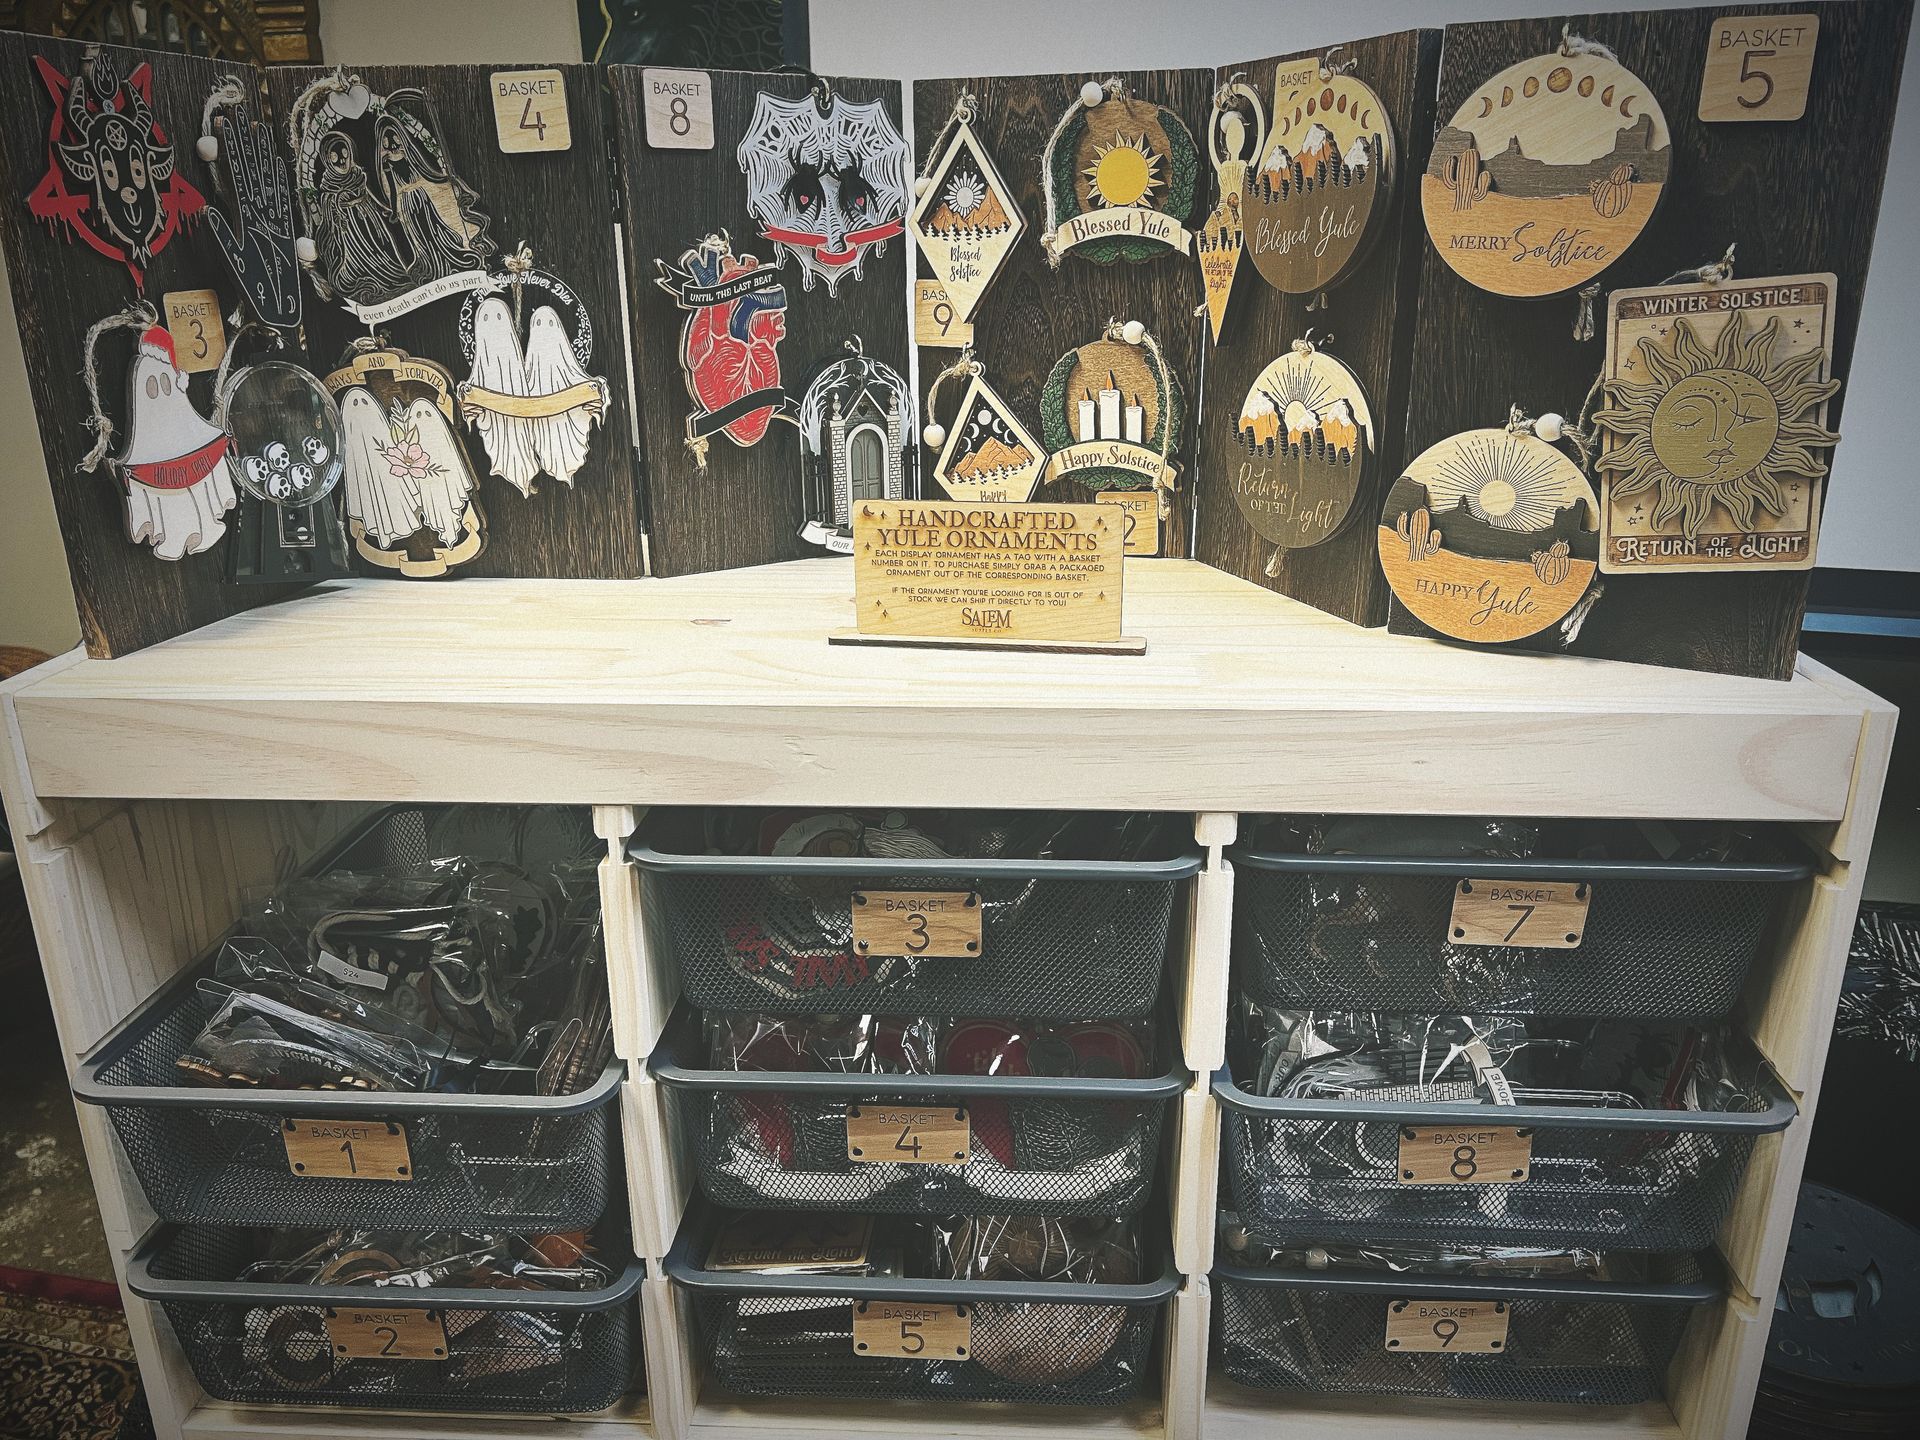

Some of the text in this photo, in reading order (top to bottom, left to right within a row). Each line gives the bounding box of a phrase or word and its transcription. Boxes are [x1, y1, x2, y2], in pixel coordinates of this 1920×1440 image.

[1720, 27, 1807, 49] BASKET
[498, 80, 556, 97] BASKET
[653, 81, 701, 97] BASKET
[1280, 71, 1313, 88] BASKET
[1737, 50, 1776, 109] 5
[519, 97, 547, 141] 4
[669, 97, 691, 136] 8
[1070, 211, 1170, 242] Blessed Yule
[1255, 205, 1361, 258] Blessed Yule
[950, 245, 982, 263] Blessed
[1449, 221, 1613, 268] MERRY Solstice
[949, 262, 982, 282] Solstice
[363, 275, 483, 321] even death can't do us part
[496, 272, 518, 289] Love
[519, 270, 552, 290] Never
[550, 283, 574, 306] Dies
[690, 274, 773, 302] UNTIL THE LAST BEAT
[922, 289, 950, 301] BAS
[173, 303, 212, 319] BASKET
[1642, 288, 1801, 315] WINTER SOLSTICE
[933, 302, 954, 337] 9
[189, 318, 208, 360] 3
[368, 356, 386, 368] AND
[405, 367, 444, 390] FOREVER
[1060, 444, 1161, 474] Happy Solstice
[153, 465, 188, 487] HOLIDAY
[1237, 462, 1289, 499] Return
[1250, 499, 1264, 511] OF
[1286, 491, 1340, 533] Light
[898, 509, 1077, 530] HANDCRAFTED
[832, 540, 850, 550] OUR
[877, 528, 1098, 551] YULE ORNAMENTS
[1616, 533, 1802, 562] RETURN OF THE LIGHT
[871, 559, 906, 568] NUMBER
[906, 560, 919, 568] ON
[947, 561, 989, 570] PURCHASE
[992, 562, 1021, 571] SIMPLY
[1023, 563, 1046, 571] GRAB
[875, 549, 898, 558] EACH
[900, 550, 932, 559] DISPLAY
[935, 551, 981, 560] ORNAMENT
[983, 552, 1001, 560] HAS
[1034, 553, 1056, 561] WITH
[1069, 554, 1101, 563] BASKET
[886, 569, 1089, 582] ORNAMENT OUT OF THE CORRESPONDING BASKET.
[902, 587, 915, 595] THE
[917, 588, 960, 596] ORNAMENT
[991, 589, 1025, 597] LOOKING
[1027, 590, 1042, 598] FOR
[1054, 591, 1070, 599] OUT
[1072, 591, 1084, 599] OF
[908, 595, 933, 603] STOCK
[950, 596, 968, 604] CAN
[997, 598, 1032, 606] DIRECTLY
[1415, 578, 1540, 626] HAPPY Yule
[961, 606, 1013, 629] SALEM
[885, 898, 947, 912] BASKET
[1490, 888, 1555, 902] BASKET
[905, 913, 930, 952] 3
[1504, 904, 1536, 943] 7
[879, 1112, 937, 1126] BASKET
[311, 1126, 370, 1140] BASKET
[895, 1125, 923, 1159] 4
[1434, 1131, 1498, 1145] BASKET
[340, 1140, 357, 1174] 1
[1450, 1145, 1478, 1179] 8
[353, 1313, 409, 1325] BASKET
[883, 1308, 941, 1322] BASKET
[1419, 1307, 1477, 1318] BASKET
[374, 1326, 402, 1356] 2
[901, 1321, 925, 1354] 5
[1433, 1318, 1460, 1348] 9
